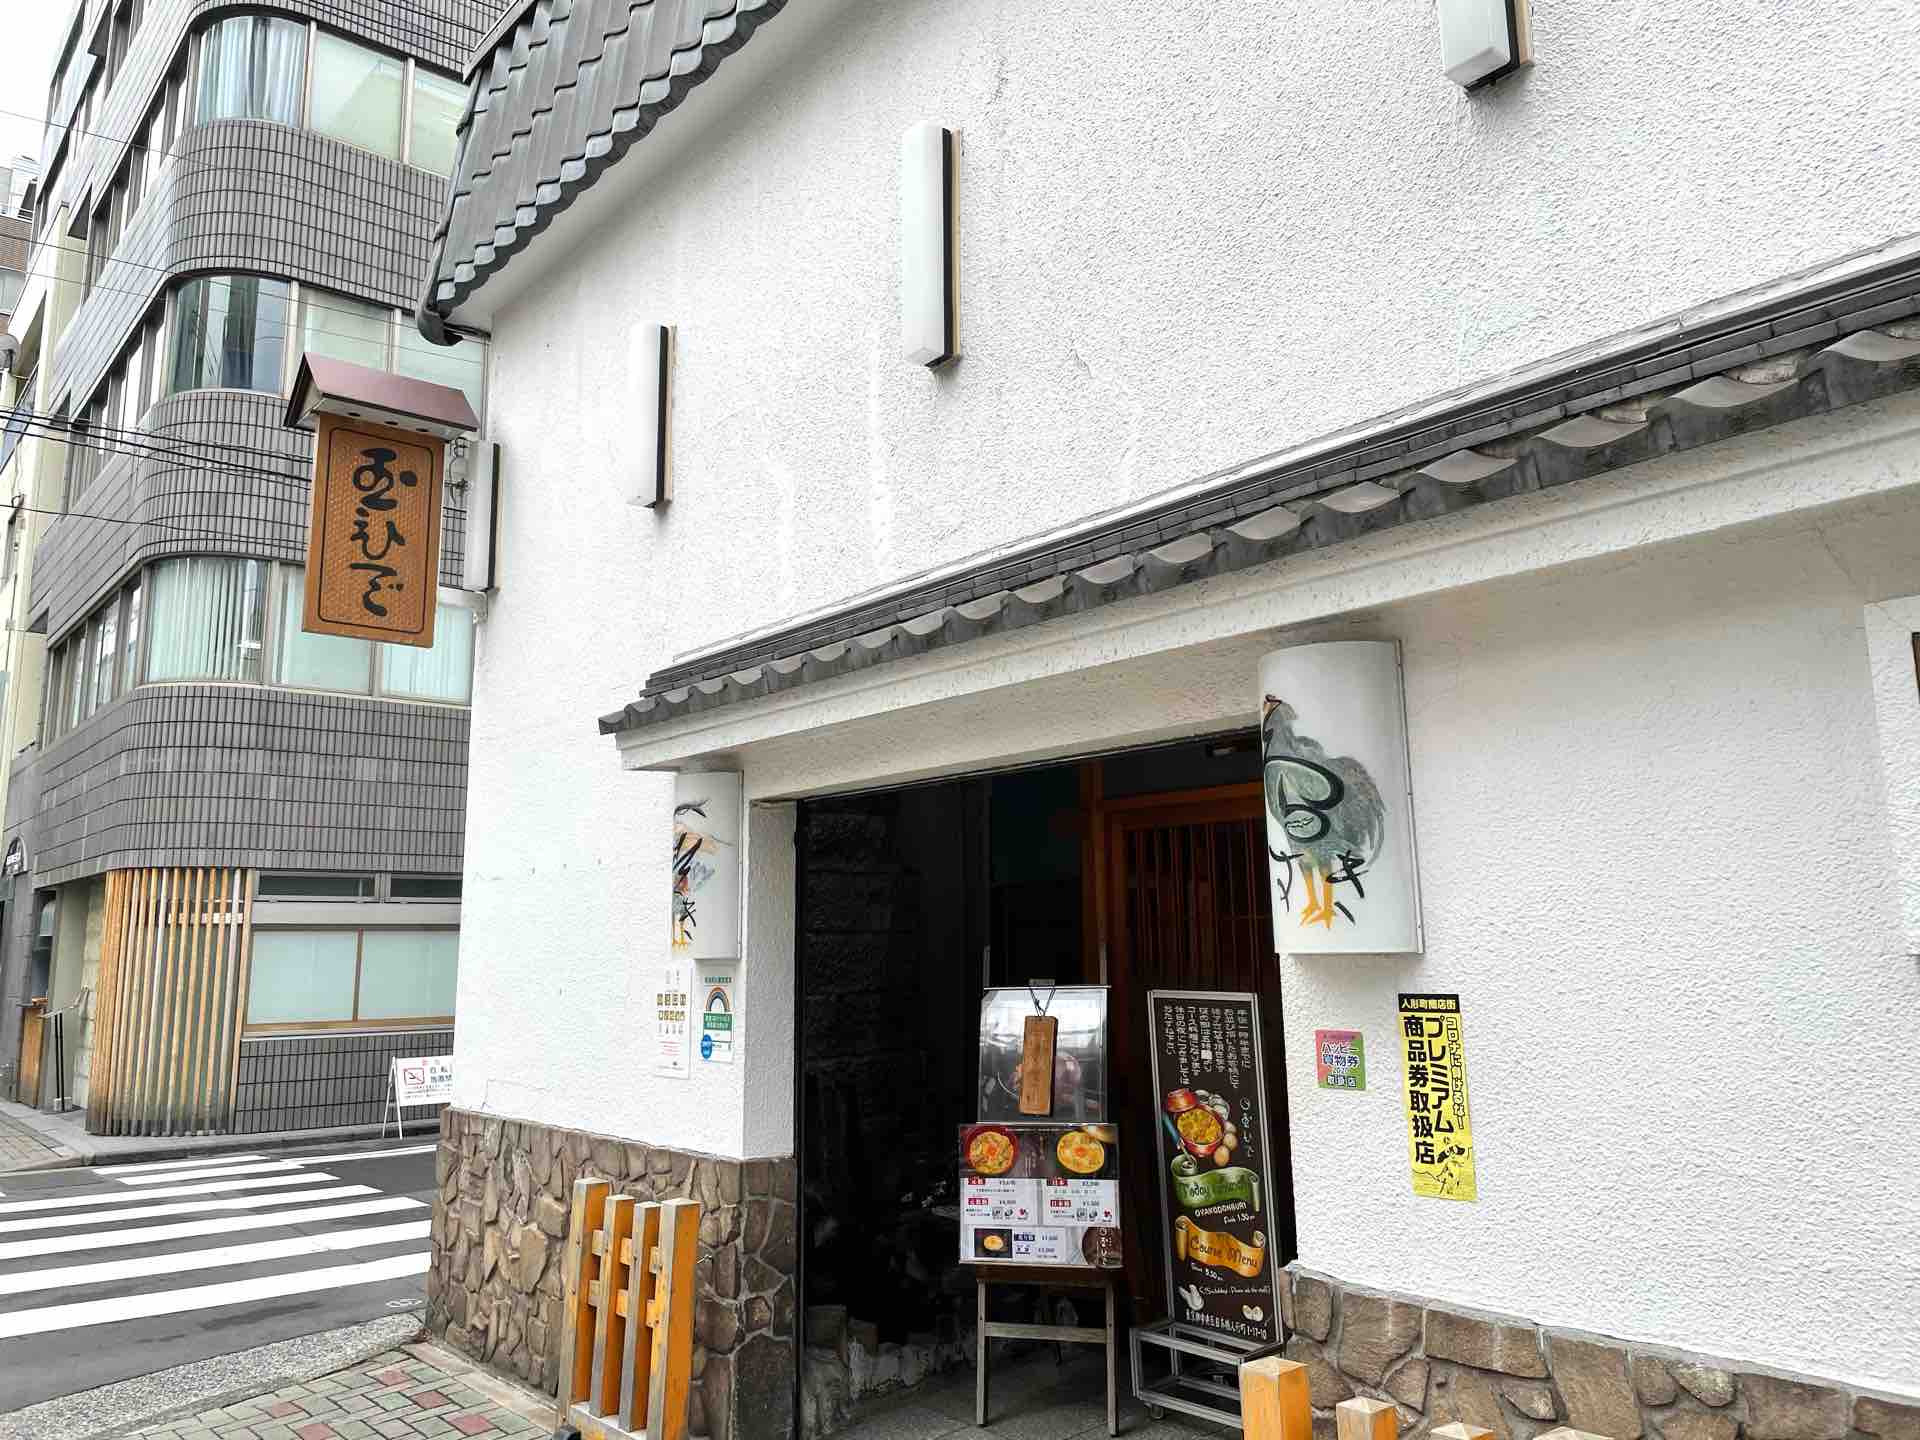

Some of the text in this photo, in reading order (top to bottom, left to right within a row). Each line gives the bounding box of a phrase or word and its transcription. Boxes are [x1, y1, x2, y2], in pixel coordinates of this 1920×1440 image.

[1403, 1015, 1435, 1165] 商品券取扱店
[1425, 1015, 1454, 1133] プレミアム
